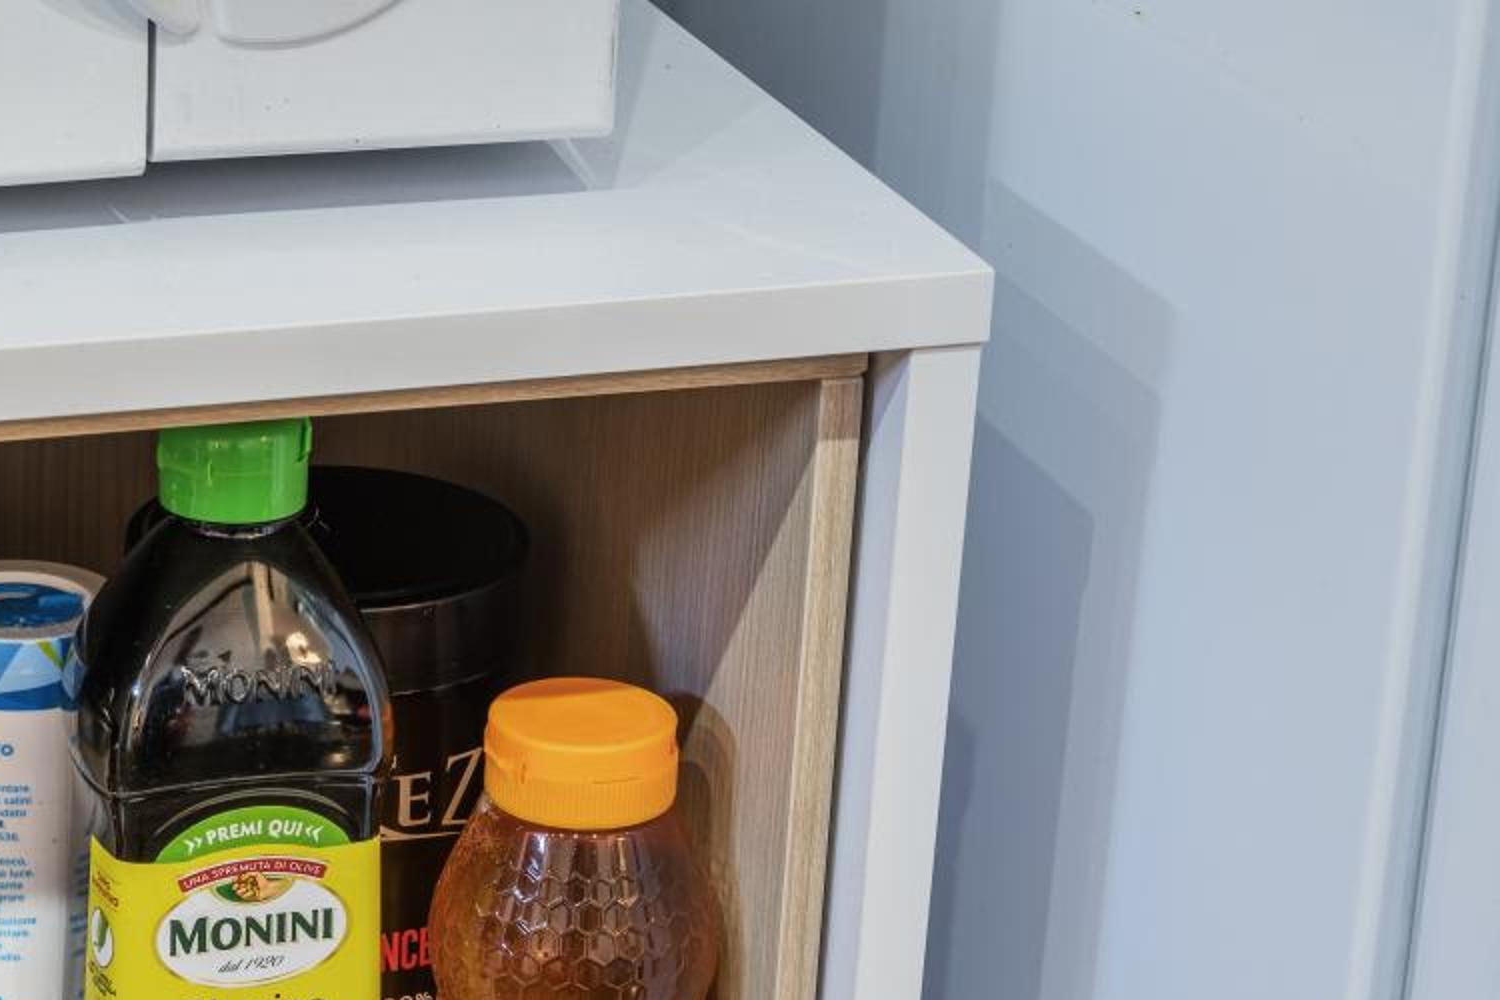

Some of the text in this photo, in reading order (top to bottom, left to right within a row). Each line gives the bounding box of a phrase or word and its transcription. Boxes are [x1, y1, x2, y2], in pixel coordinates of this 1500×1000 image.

[391, 747, 484, 828] EZ
[206, 818, 304, 844] PREMI QUI
[183, 860, 323, 890] UNA SPREMUTA DI OLIVE
[169, 907, 334, 957] MONINI
[381, 927, 431, 971] NCE
[218, 954, 286, 974] dal 1920
